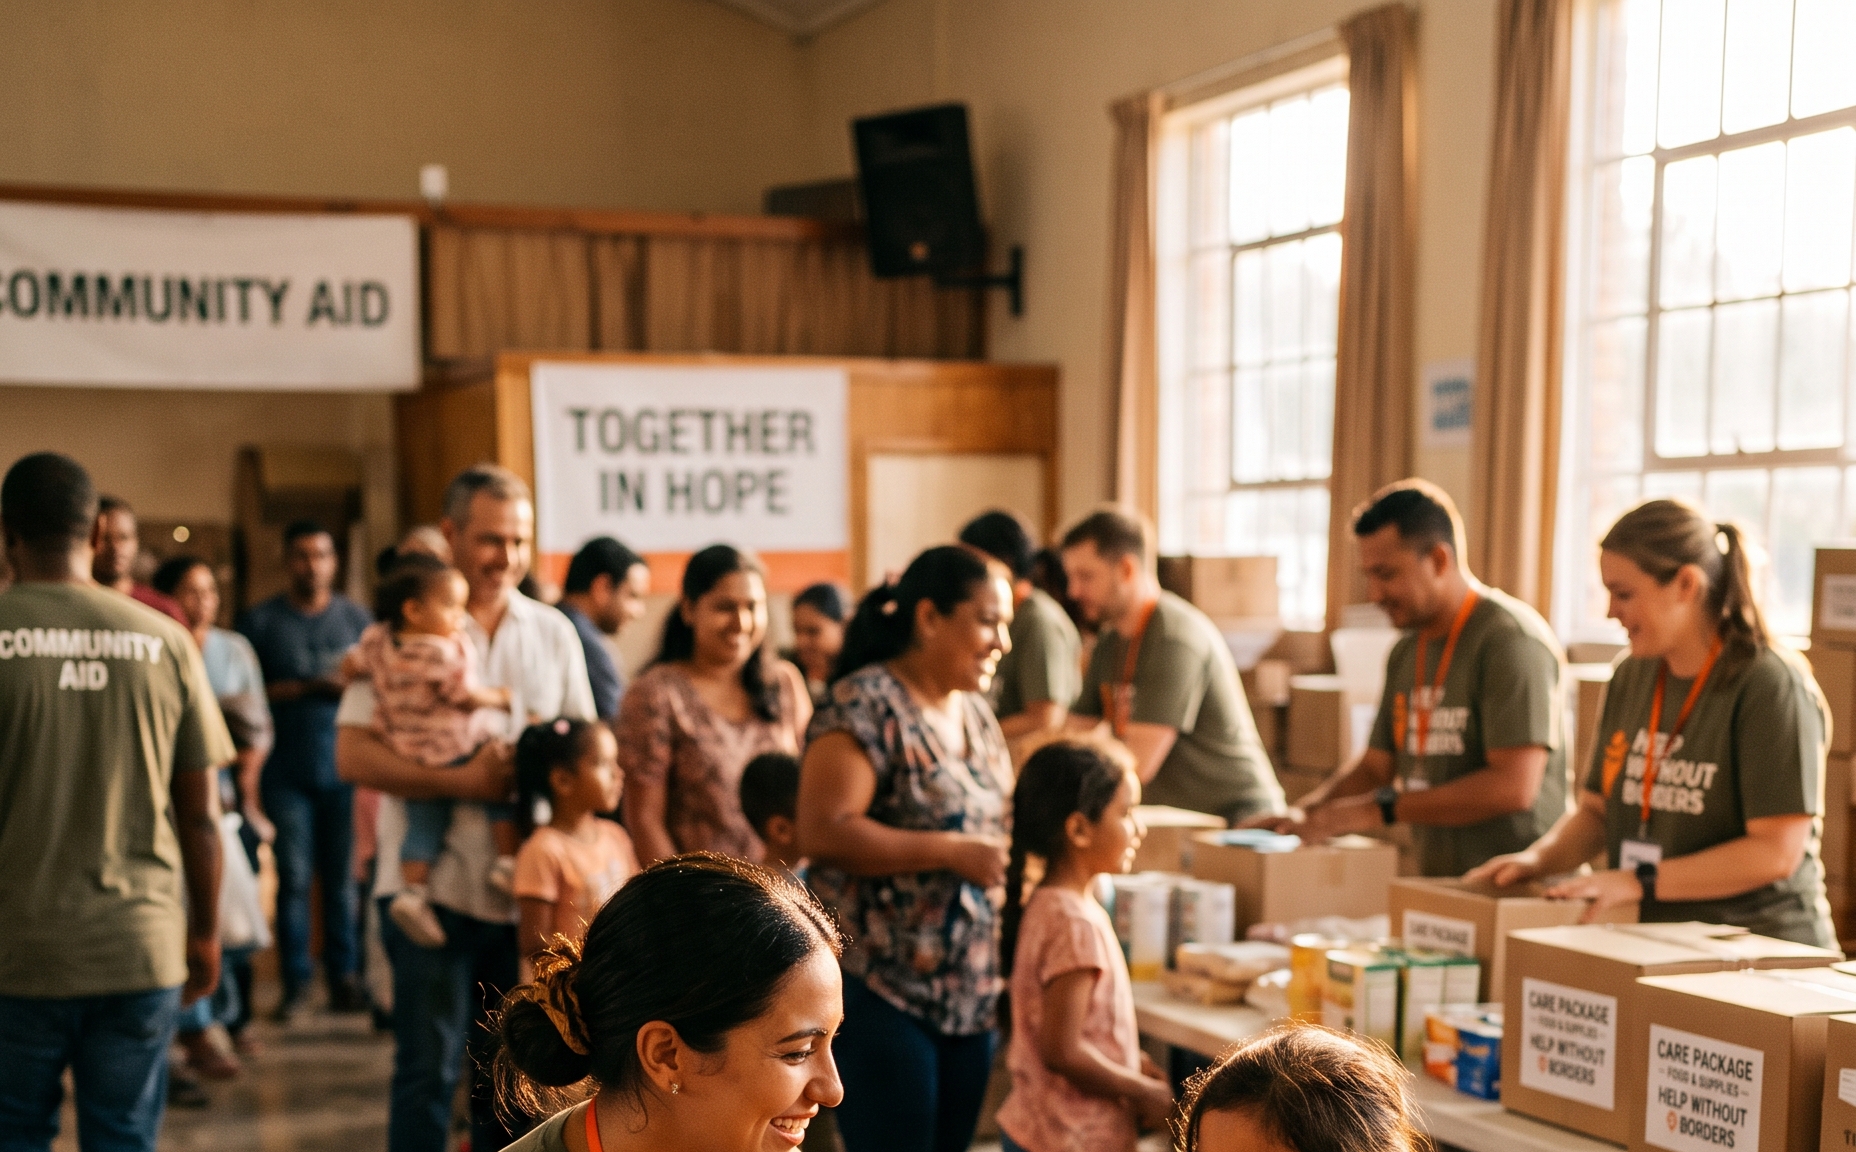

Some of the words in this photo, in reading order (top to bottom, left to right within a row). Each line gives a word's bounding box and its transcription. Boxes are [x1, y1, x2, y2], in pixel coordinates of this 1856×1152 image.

[0, 270, 290, 327] OMMUNITY
[306, 278, 391, 329] AID
[567, 408, 816, 454] TOGETHER
[599, 469, 645, 514] IN
[666, 469, 788, 515] HOPE
[0, 628, 163, 665] COMMUNITY
[58, 659, 109, 691] AID
[1626, 754, 1718, 790] WHOUT
[1529, 991, 1555, 1013] CARE
[1558, 997, 1608, 1025] PACKAGE
[1530, 1033, 1555, 1053] HELP
[1558, 1040, 1606, 1067] WITHOUT
[1657, 1039, 1689, 1065] CARE
[1693, 1048, 1753, 1081] PACKAGE
[1548, 1059, 1595, 1086] BORDERS
[1667, 1066, 1689, 1083] FOOD
[1699, 1075, 1739, 1098] SUPPLIES
[1658, 1086, 1688, 1110] HELP
[1691, 1095, 1747, 1128] WITHOUT
[1680, 1115, 1735, 1149] BORDERS
